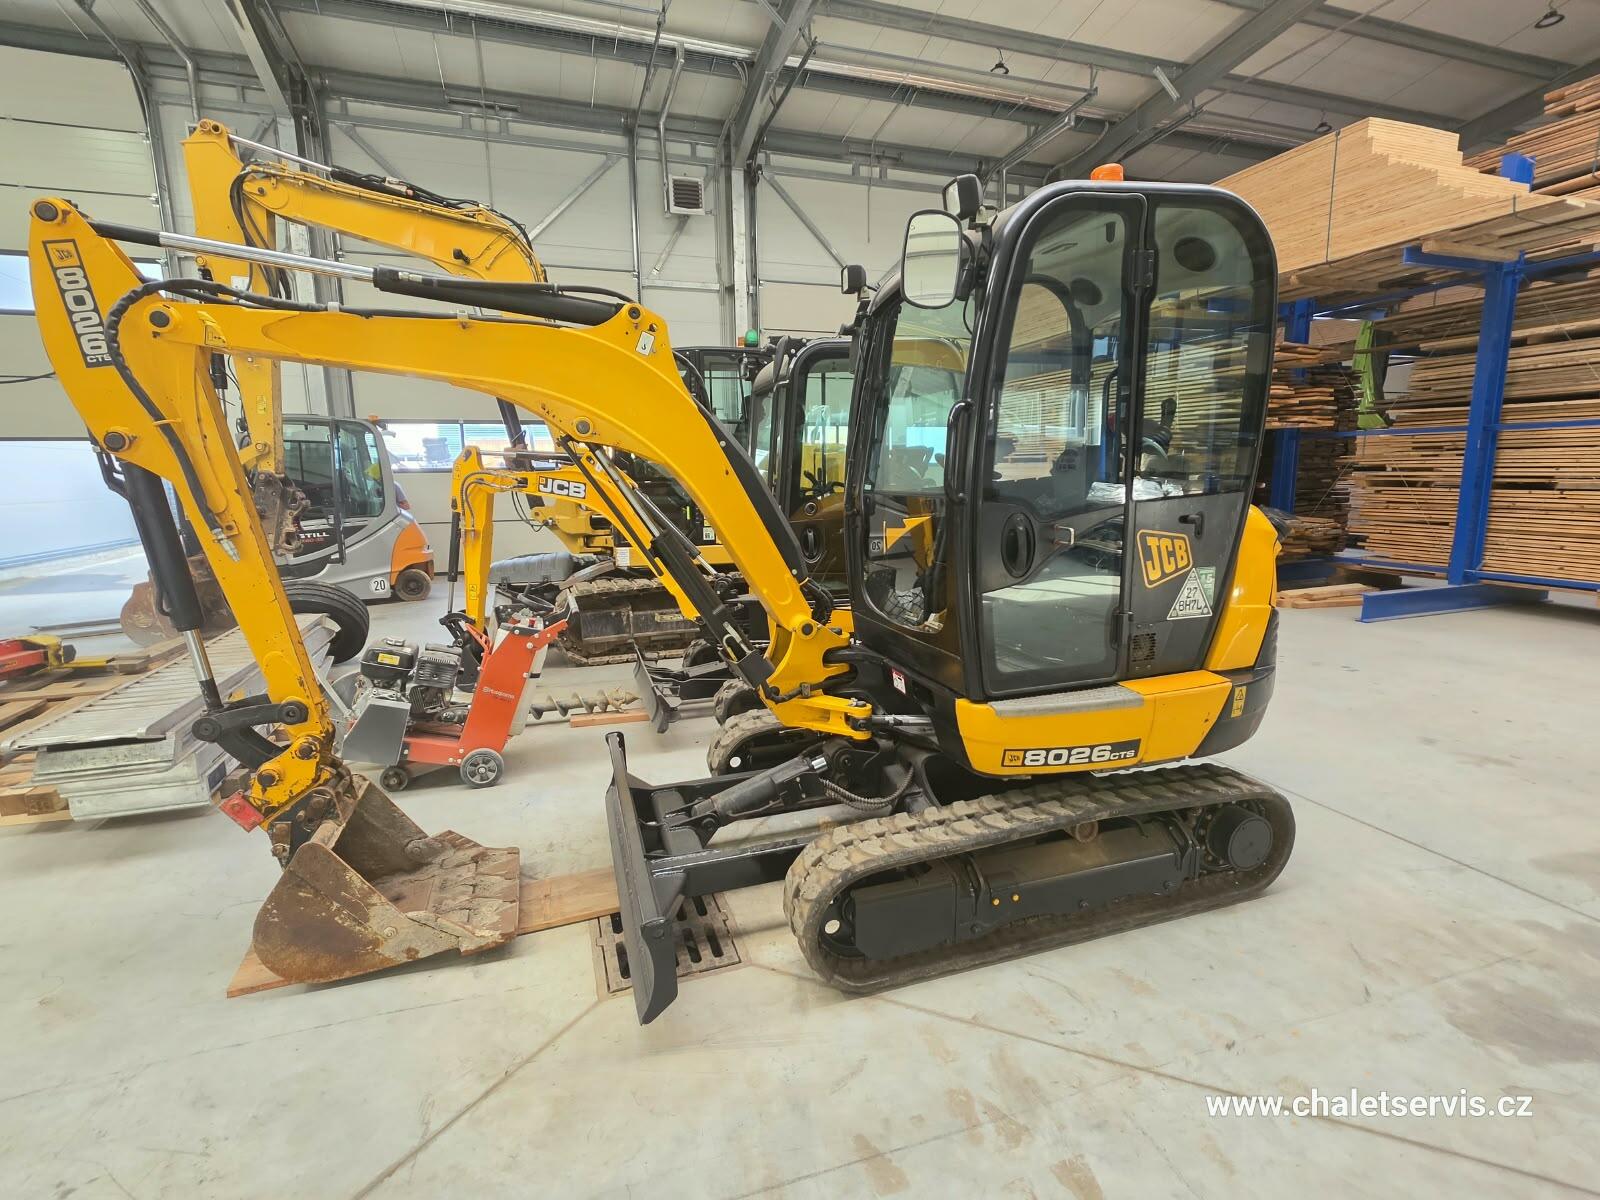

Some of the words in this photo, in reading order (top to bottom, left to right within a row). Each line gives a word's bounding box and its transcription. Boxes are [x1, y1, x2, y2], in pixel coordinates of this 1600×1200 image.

[539, 477, 586, 498] JCB
[299, 531, 330, 539] STILL
[1146, 536, 1189, 581] JCB
[374, 579, 386, 591] 20
[1186, 587, 1198, 599] 27
